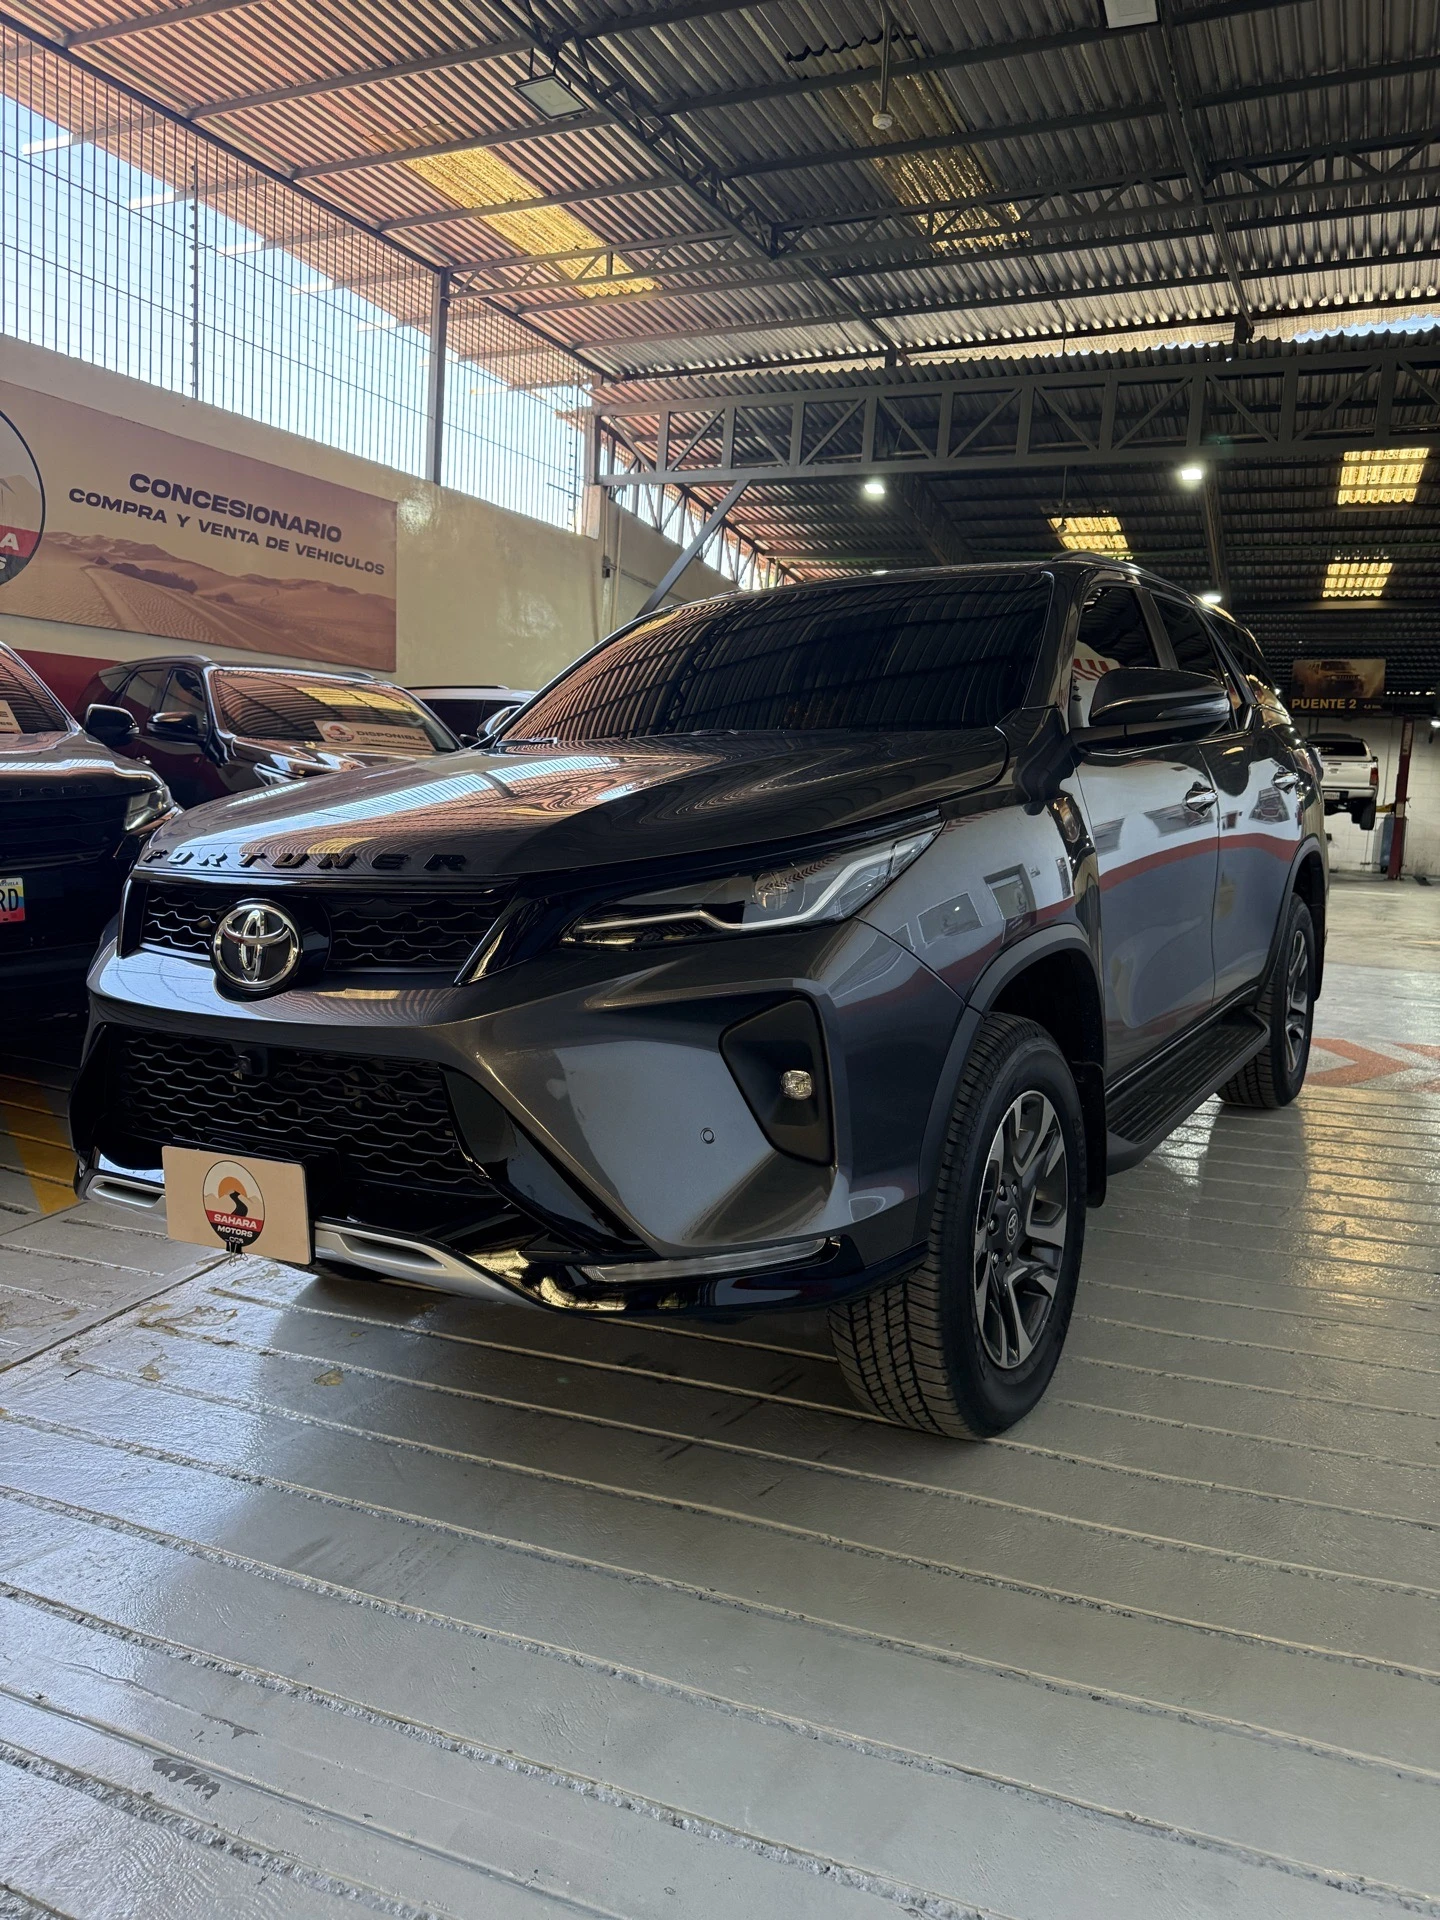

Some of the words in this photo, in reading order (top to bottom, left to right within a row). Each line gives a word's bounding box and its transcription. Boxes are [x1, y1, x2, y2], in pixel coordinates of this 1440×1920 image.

[129, 473, 342, 543] CONCESIONARIO
[68, 488, 167, 523] COMPRA
[176, 513, 191, 528] Y
[198, 519, 259, 545] VENTA
[265, 536, 290, 552] DE
[295, 543, 385, 575] VEHICULOS
[1291, 698, 1346, 709] PUENTE
[1349, 698, 1357, 709] 2
[356, 730, 427, 741] DISPONIBLE
[143, 849, 467, 870] FORTUNER
[213, 1213, 257, 1229] SAHARA
[217, 1224, 253, 1238] MOTORS
